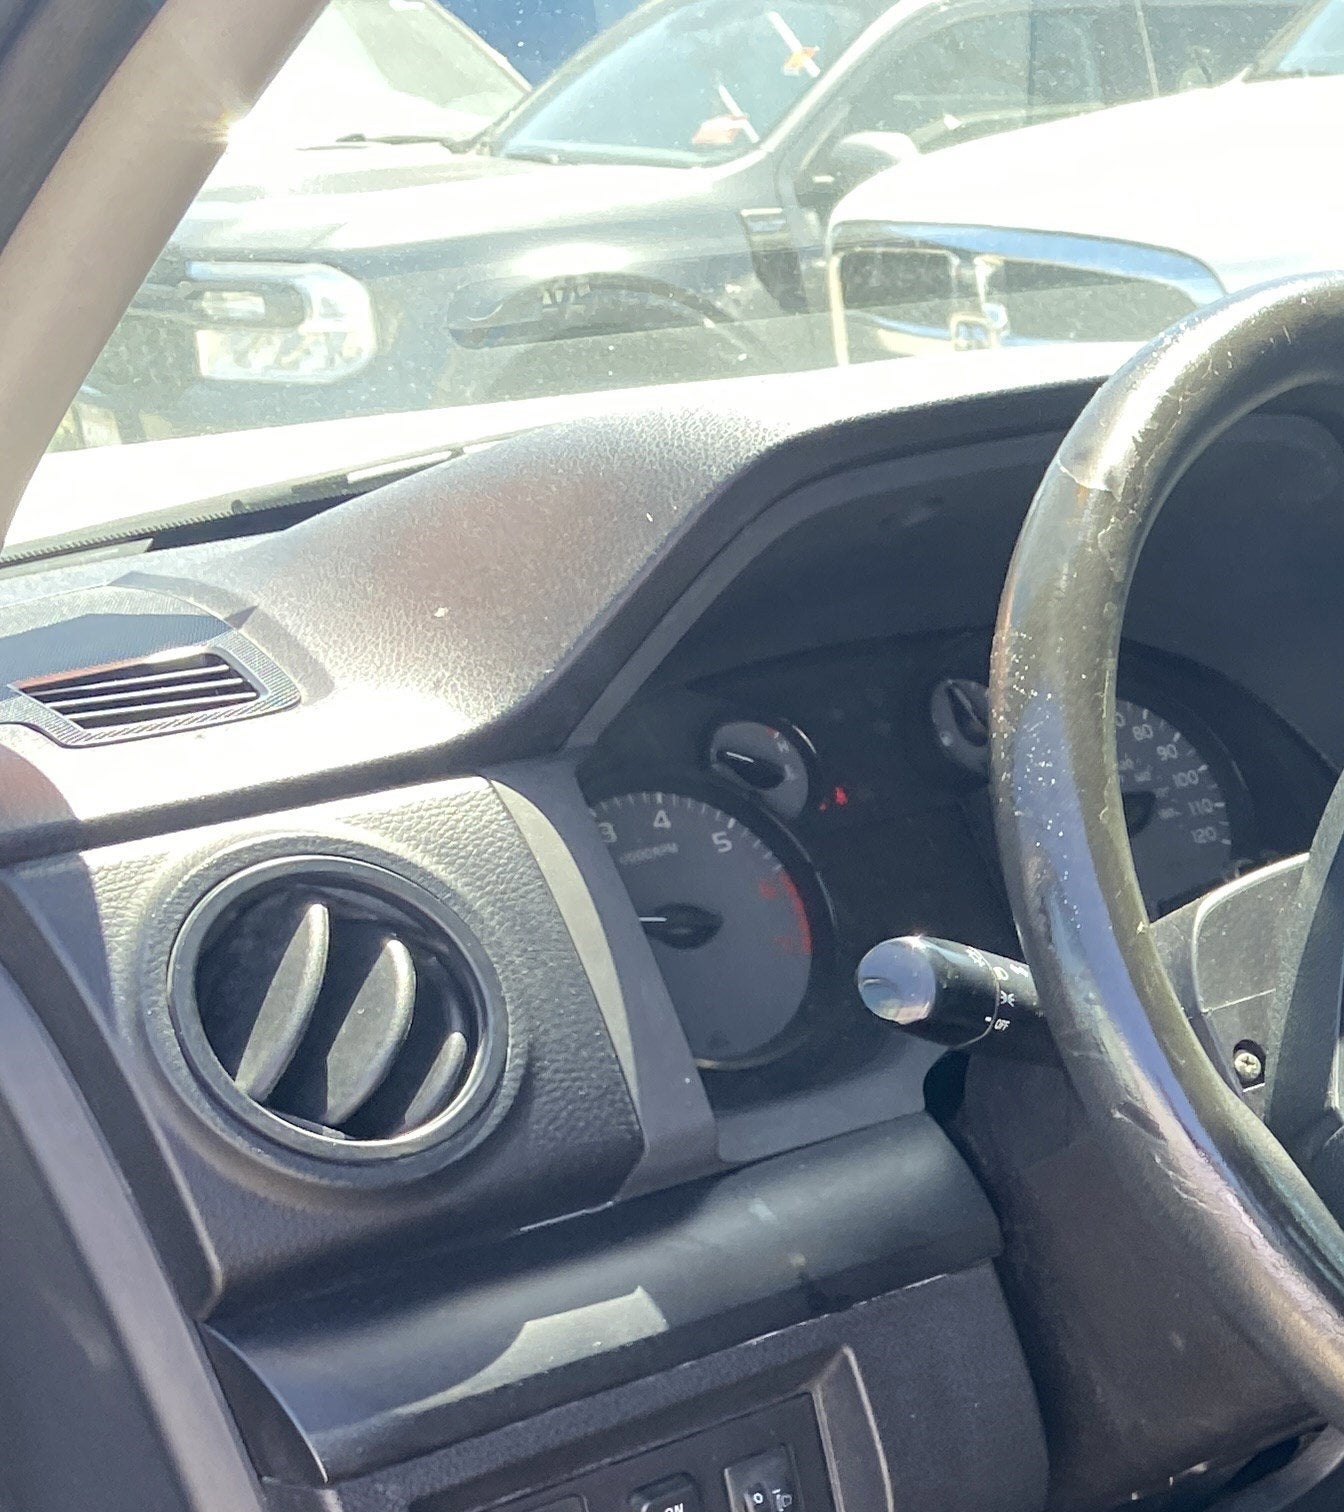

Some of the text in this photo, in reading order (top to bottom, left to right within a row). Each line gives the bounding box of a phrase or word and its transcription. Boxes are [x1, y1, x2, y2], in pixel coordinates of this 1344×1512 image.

[1132, 723, 1154, 741] 80
[1156, 743, 1178, 762] 90
[1172, 769, 1199, 787] 100
[1188, 798, 1214, 816] 110
[653, 809, 672, 829] 4
[599, 822, 618, 843] 3
[1190, 826, 1217, 844] 120
[711, 831, 733, 853] 5
